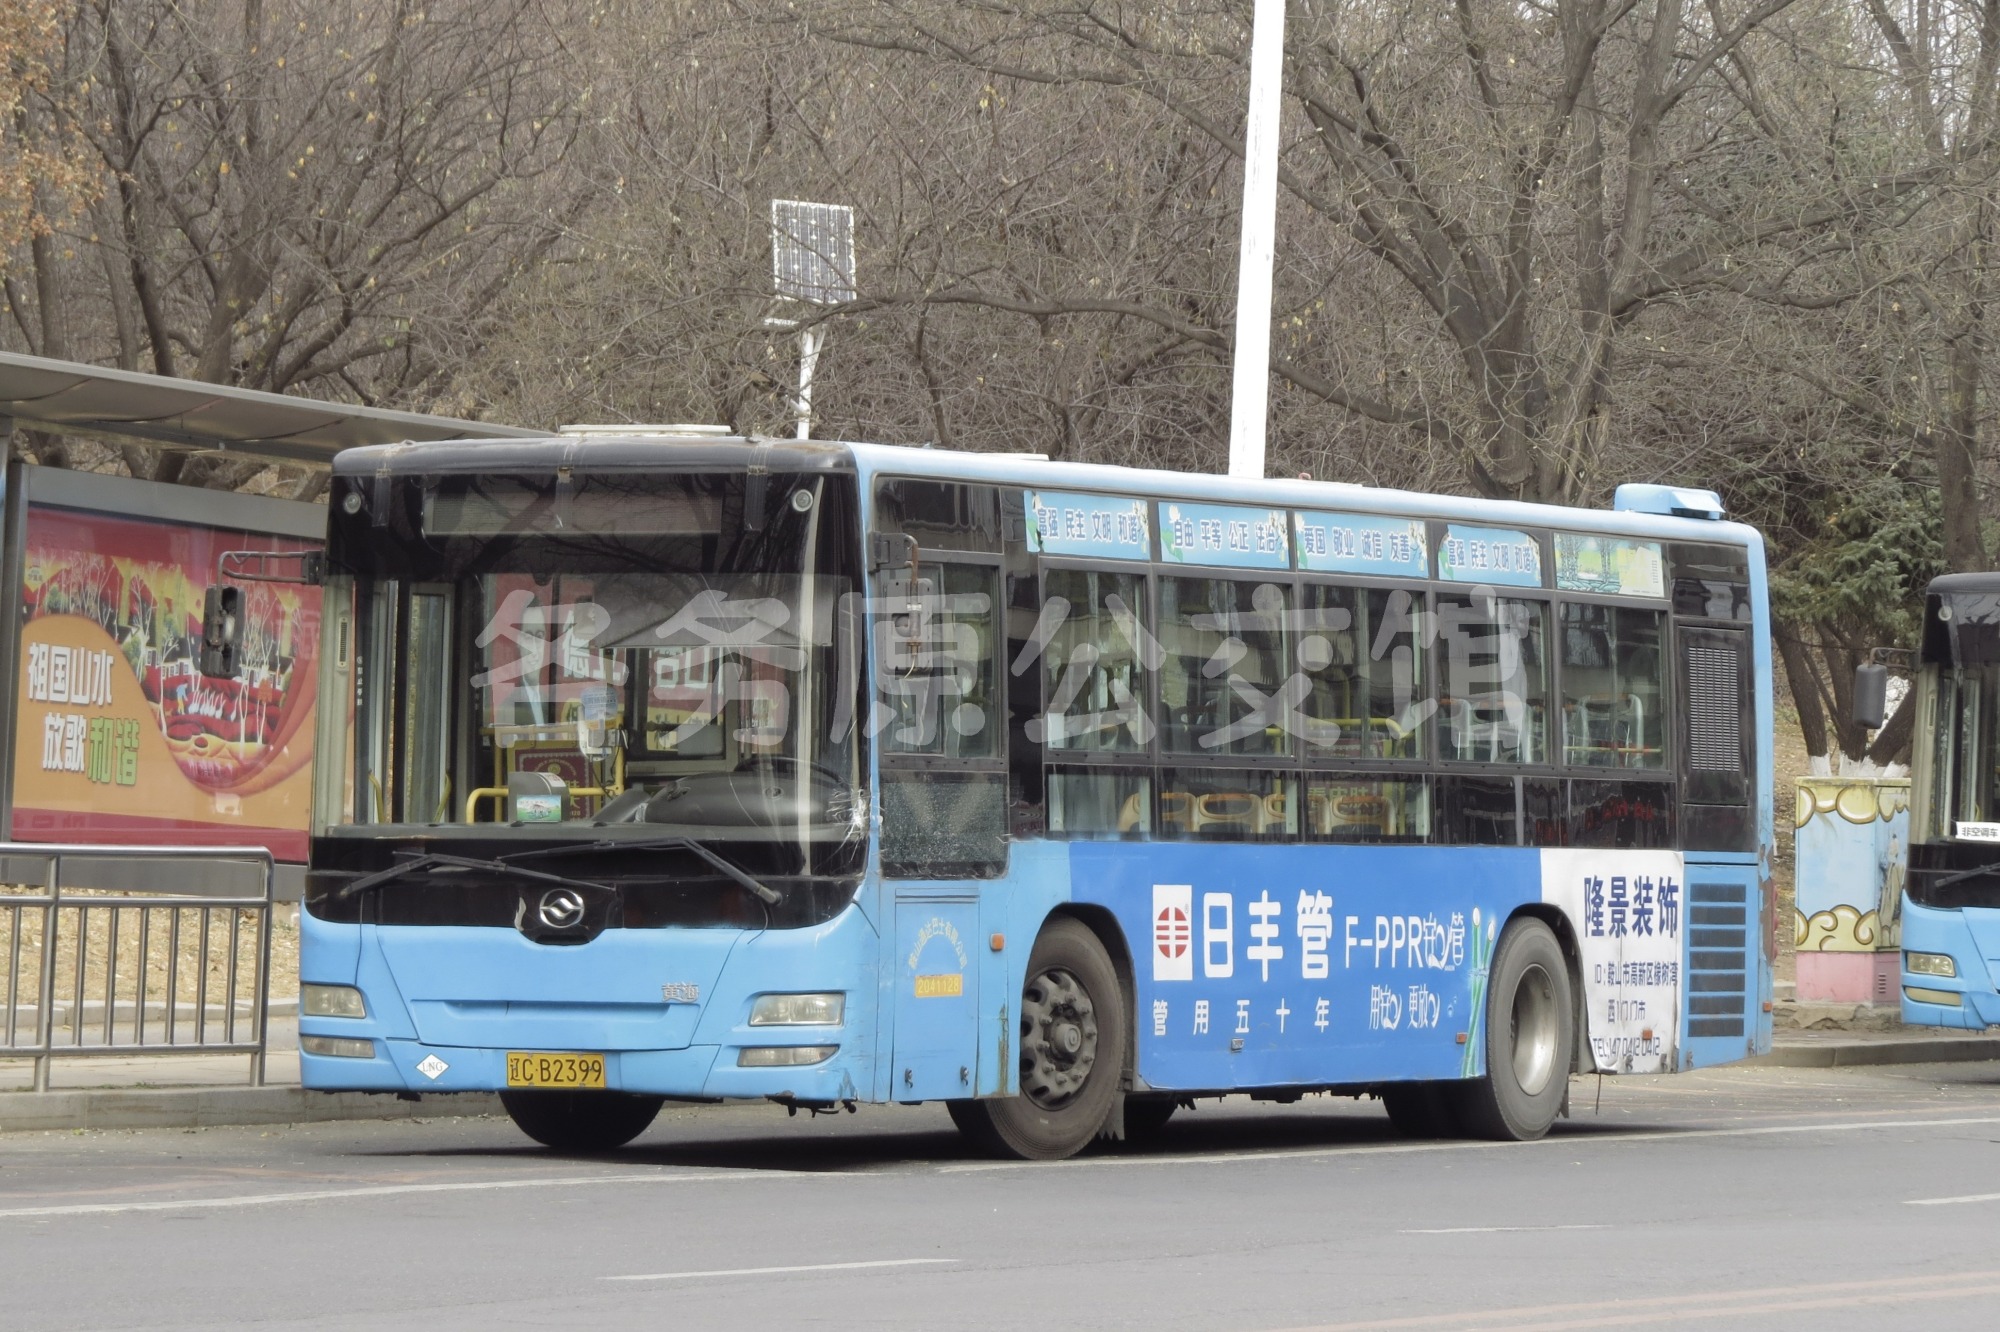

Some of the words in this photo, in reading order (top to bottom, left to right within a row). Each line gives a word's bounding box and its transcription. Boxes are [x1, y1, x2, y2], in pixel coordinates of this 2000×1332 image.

[1036, 507, 1059, 539] 富强
[1065, 508, 1086, 541] 民主
[1091, 510, 1112, 543] 文明
[1118, 512, 1139, 545] 和谐
[1173, 518, 1194, 549] 自由
[1200, 519, 1221, 551] 平等
[1228, 520, 1249, 552] 公正
[1255, 521, 1276, 554] 法治
[1304, 525, 1326, 556] 爱国
[1332, 527, 1355, 558] 敬业
[1361, 529, 1383, 560] 诚信
[1389, 531, 1411, 562] 友善
[1447, 538, 1466, 568] 富强
[1469, 539, 1488, 570] 民主
[1492, 541, 1510, 571] 文明
[1514, 544, 1532, 573] 和谐
[28, 642, 115, 706] 祖国山水
[42, 712, 140, 786] 放歌和谐
[1961, 826, 1999, 838] 非空调车
[1584, 874, 1679, 939] 隆景装饰
[1204, 888, 1333, 983] 日丰管
[1153, 997, 1330, 1035] 管用五十年
[421, 1061, 444, 1073] LNG
